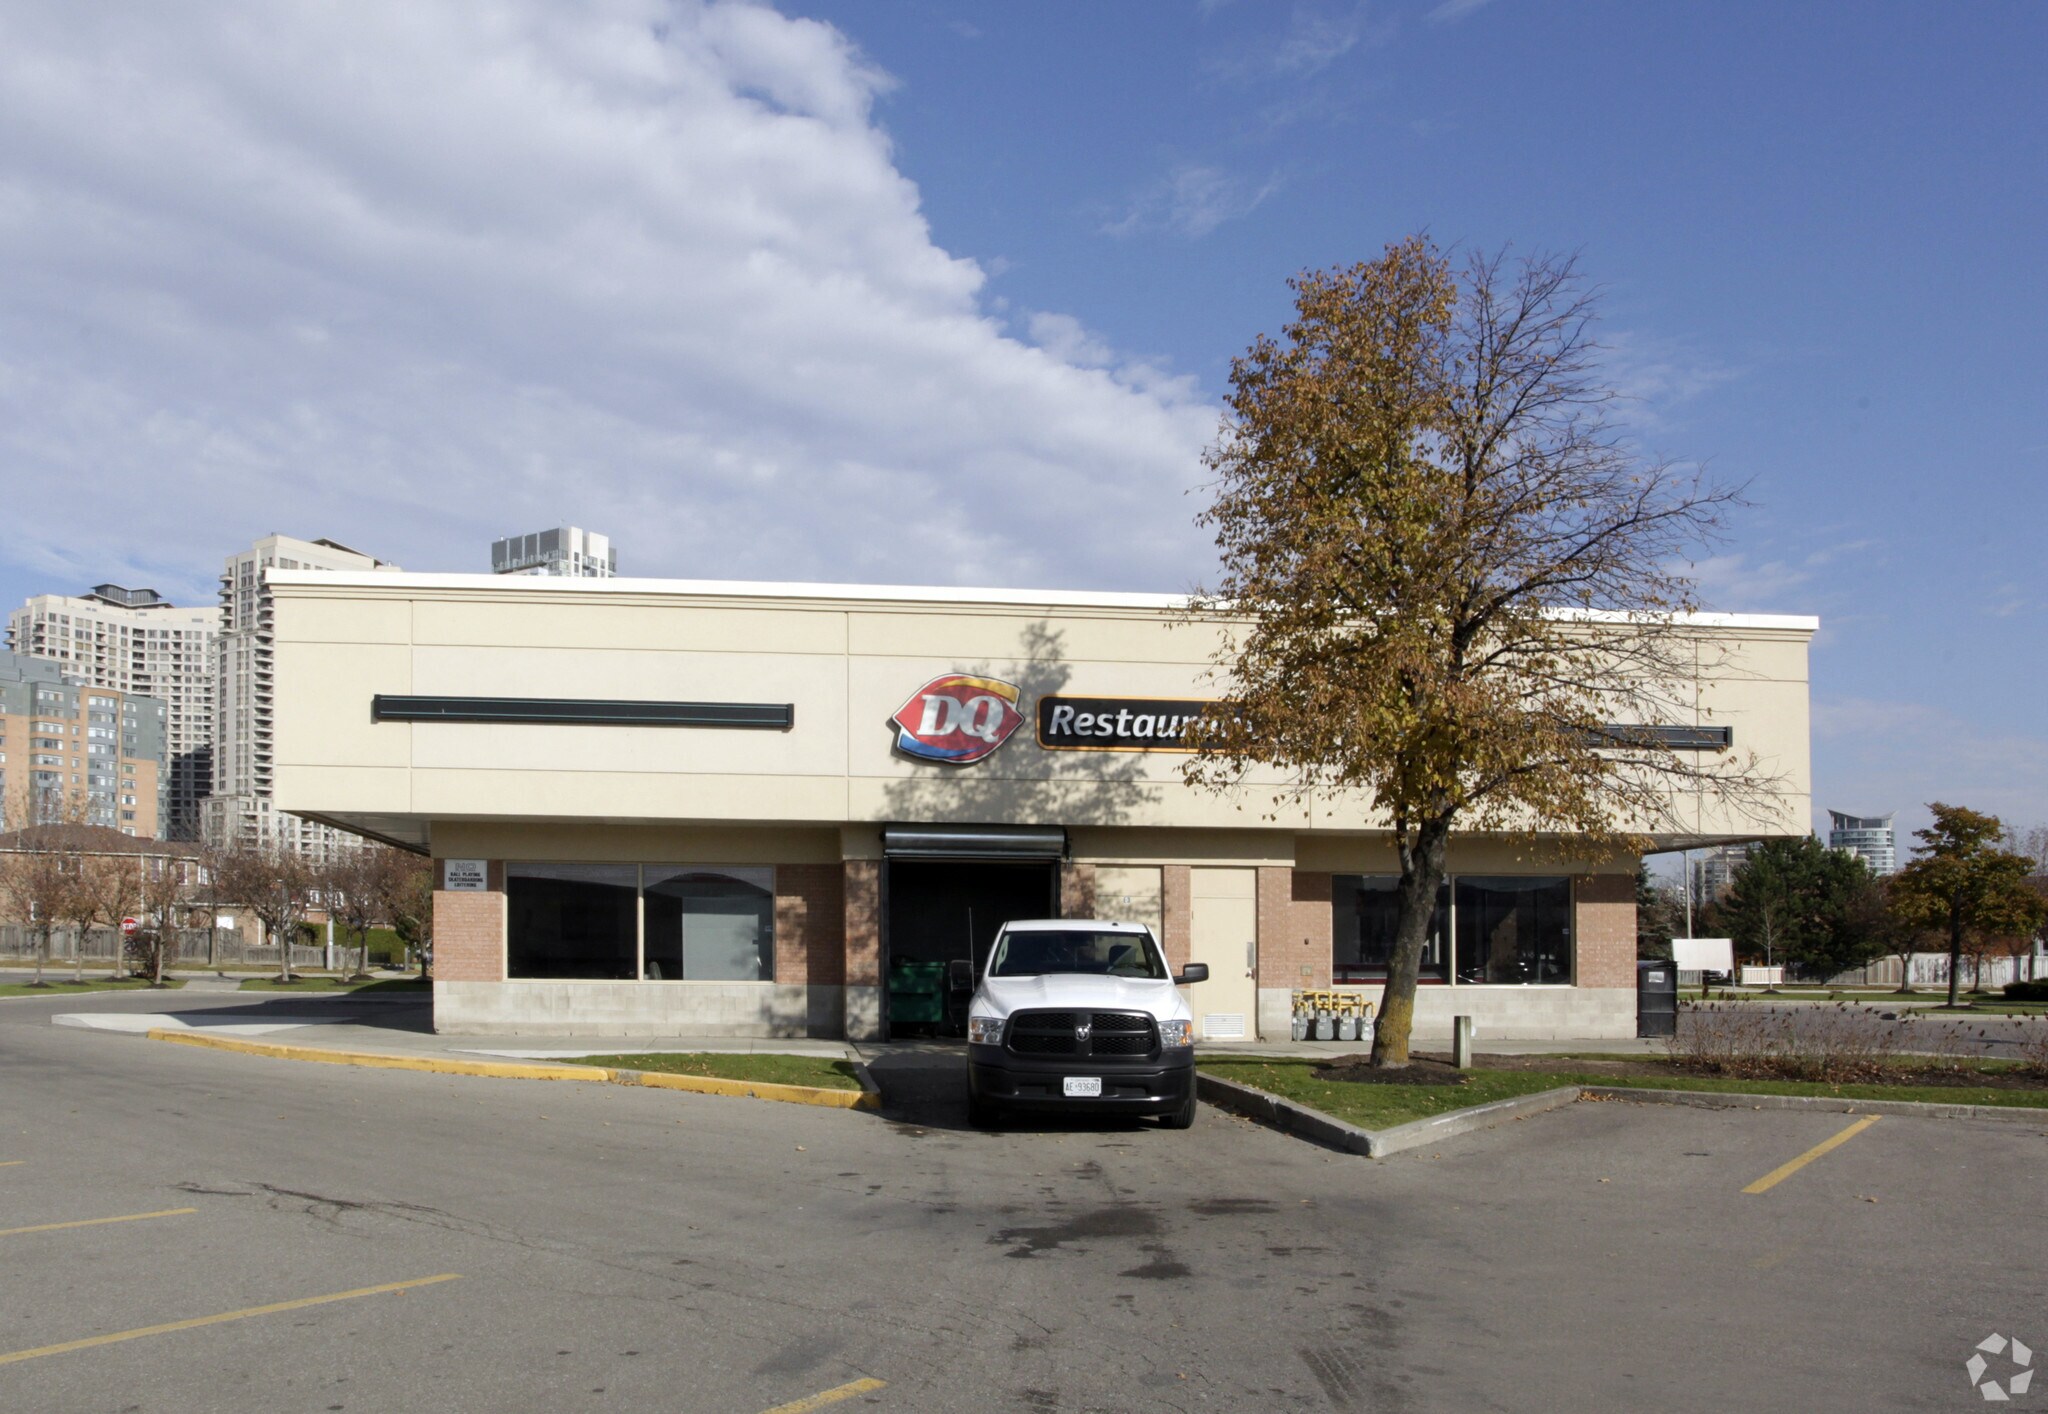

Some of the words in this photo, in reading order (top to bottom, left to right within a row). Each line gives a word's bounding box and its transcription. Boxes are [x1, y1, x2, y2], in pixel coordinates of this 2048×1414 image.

[916, 694, 1004, 743] DQ
[1049, 705, 1259, 740] Restaur
[455, 862, 477, 871] NO
